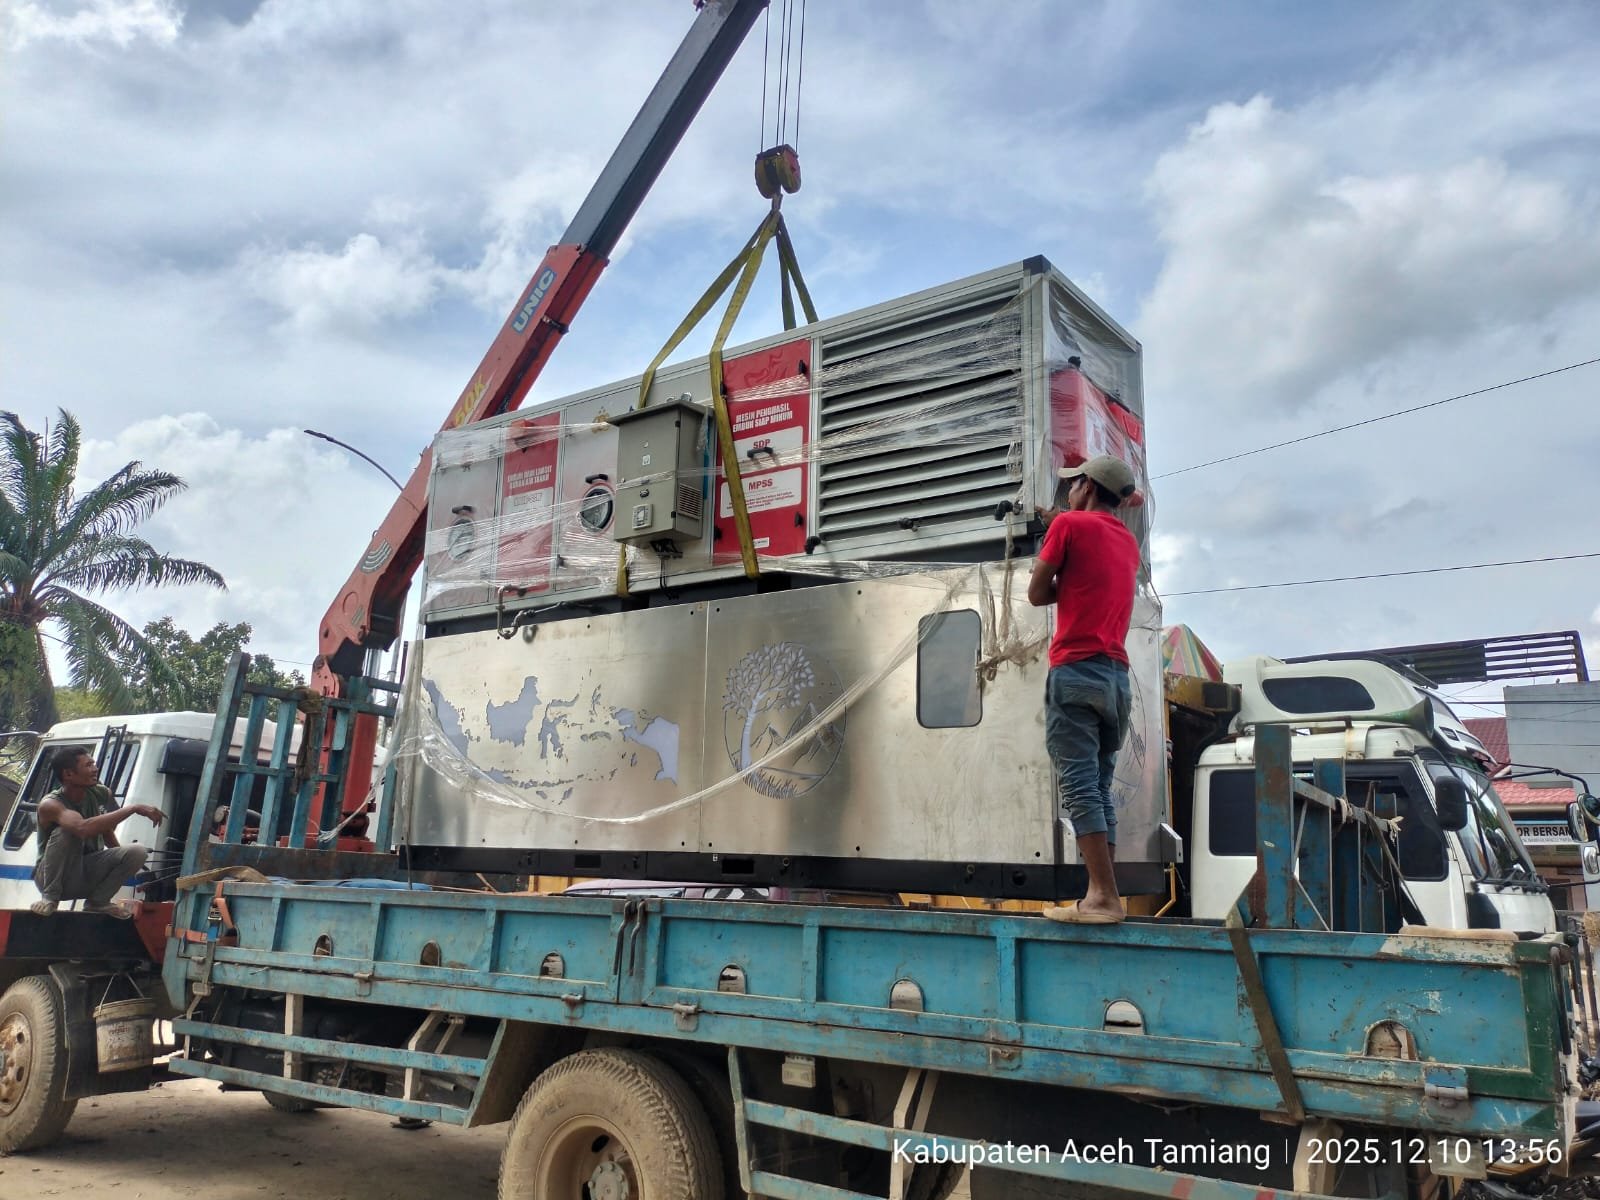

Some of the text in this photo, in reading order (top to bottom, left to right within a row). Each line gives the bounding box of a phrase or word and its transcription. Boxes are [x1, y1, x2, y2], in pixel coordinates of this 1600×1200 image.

[513, 270, 554, 332] UNIC
[753, 439, 771, 449] SDP
[748, 478, 773, 491] MPSS
